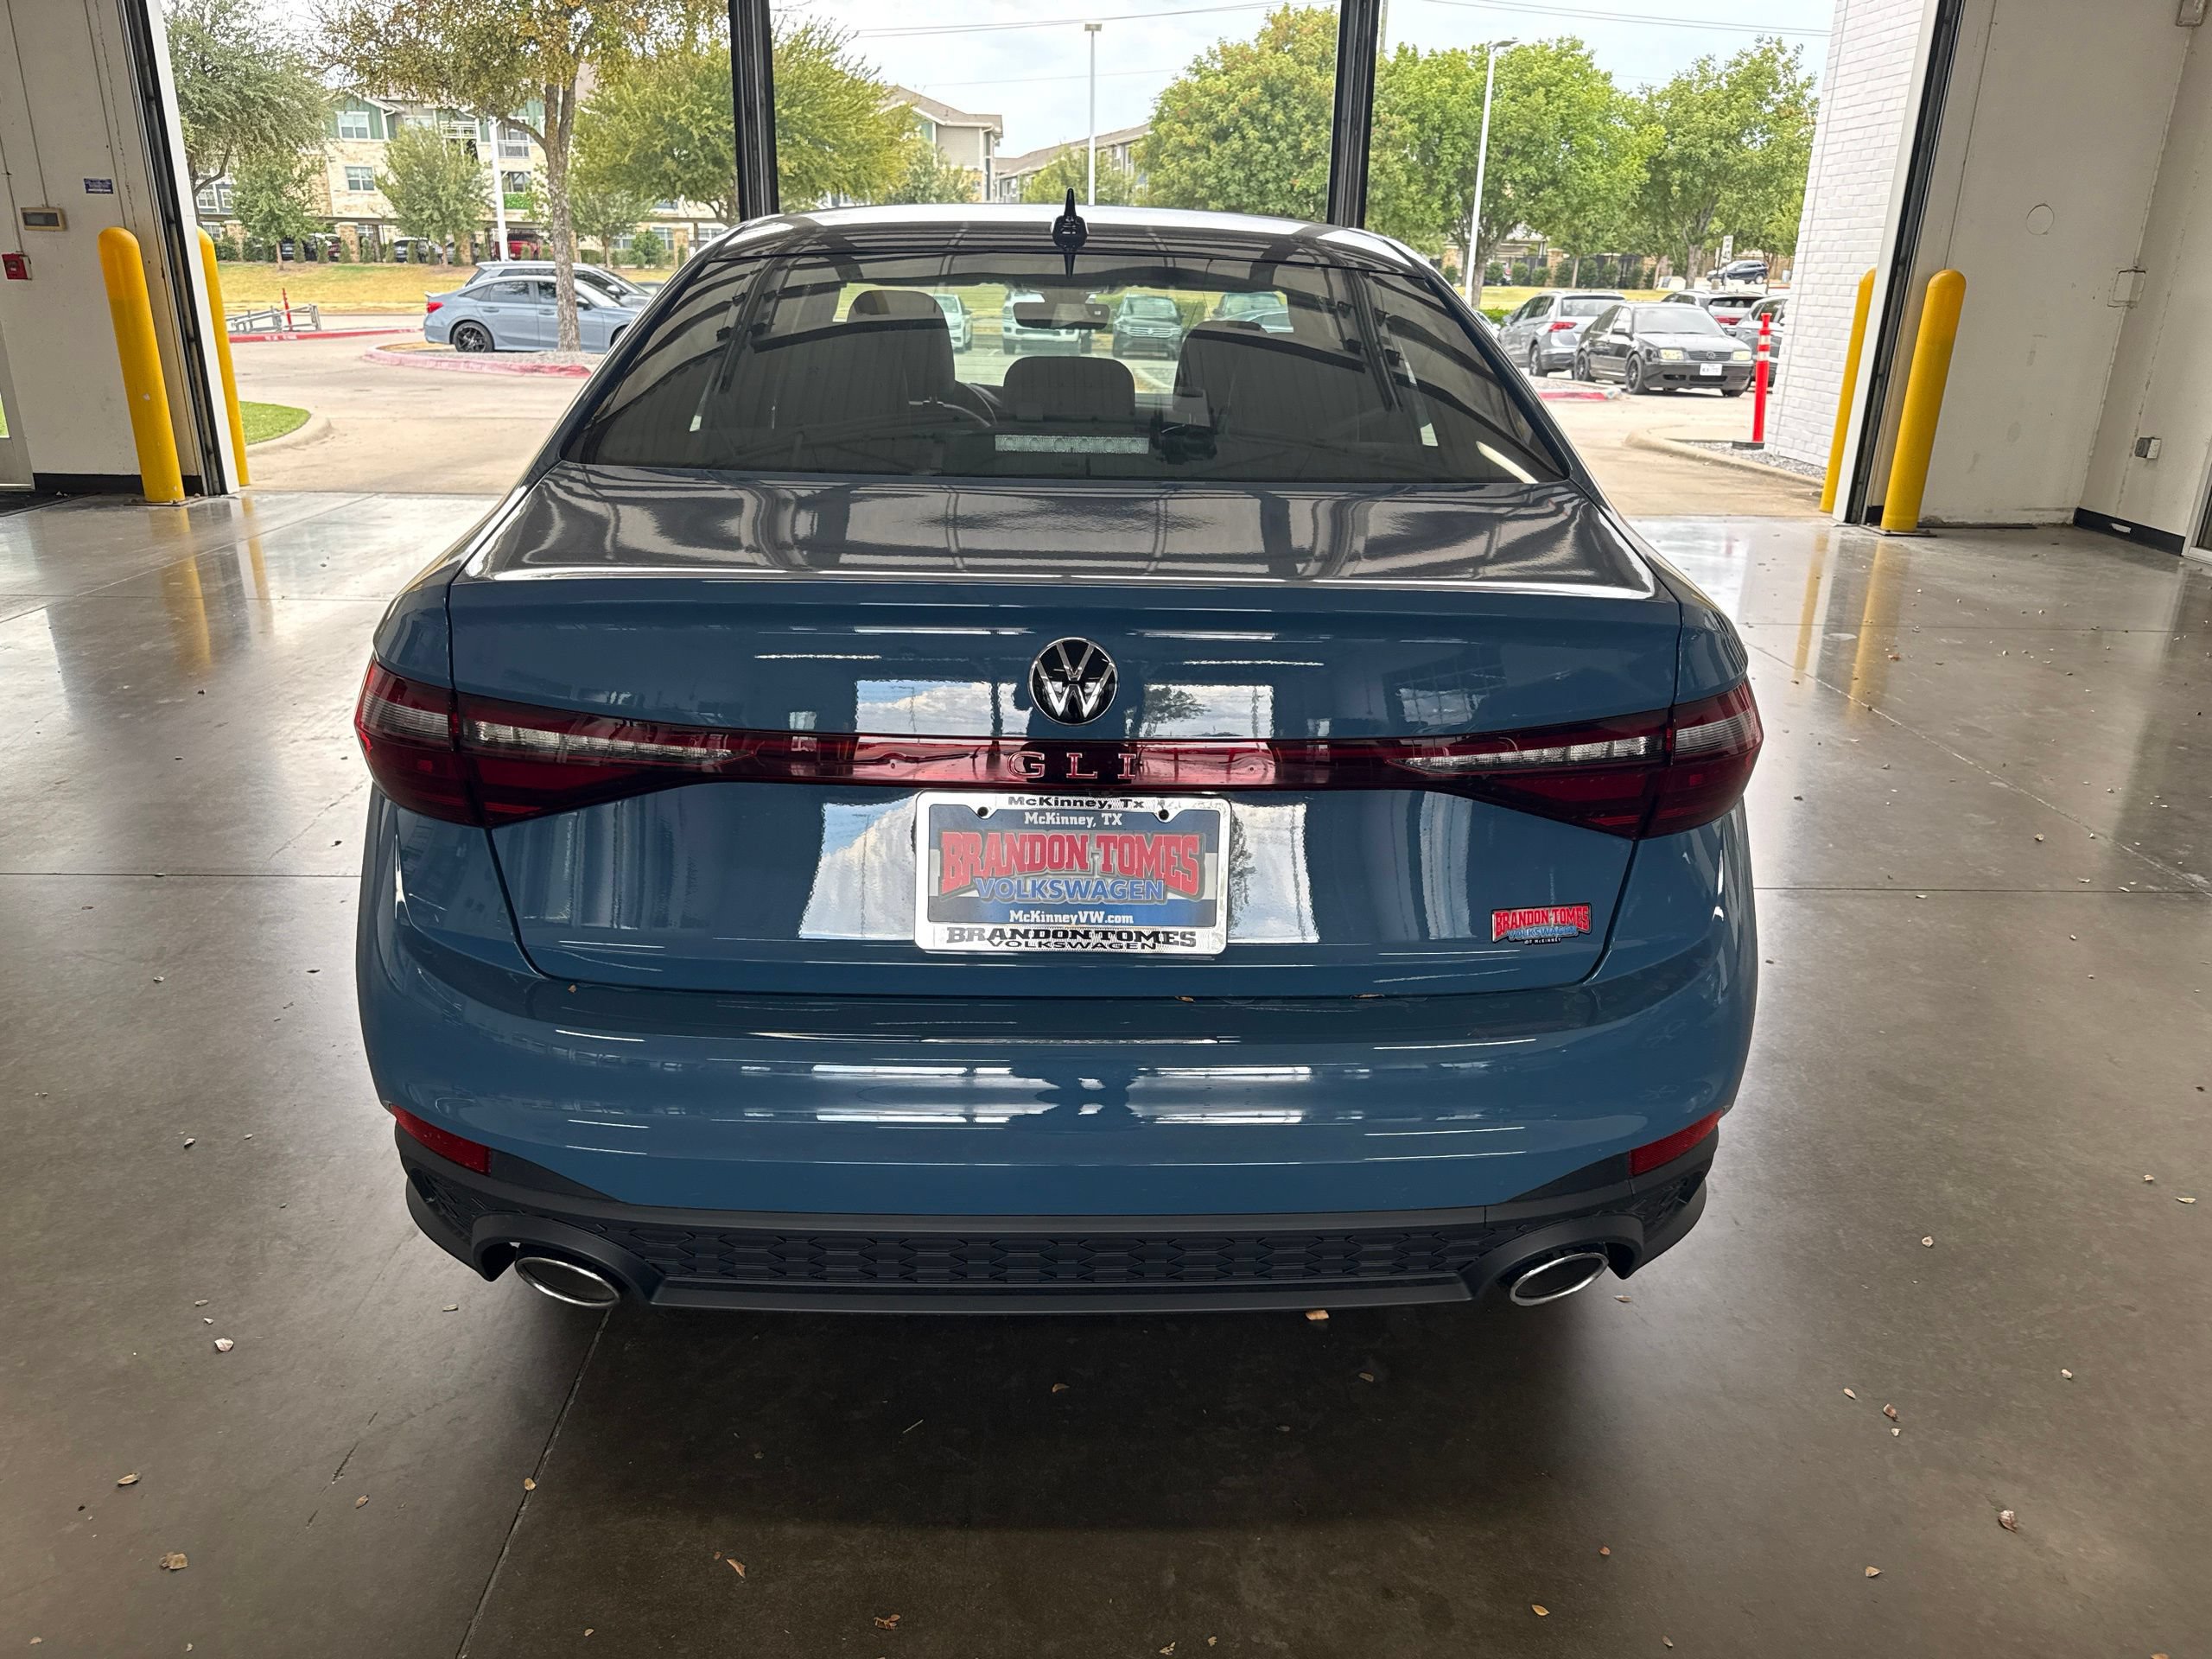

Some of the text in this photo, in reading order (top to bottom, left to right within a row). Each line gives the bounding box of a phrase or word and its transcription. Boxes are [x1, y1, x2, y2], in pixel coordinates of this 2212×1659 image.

[1007, 751, 1138, 779] GLI
[1007, 796, 1145, 809] McKinney, Tx
[1024, 812, 1122, 828] McKinney, TX
[942, 831, 1200, 896] BRANDON TOMES
[974, 877, 1165, 900] VOLKSWAGEN
[1009, 910, 1134, 925] McKinneyVW.com
[1495, 906, 1589, 938] BRANDON TOMES
[1506, 925, 1577, 939] VOLKSWAGEN
[988, 939, 1156, 950] VOLKSWAGEN
